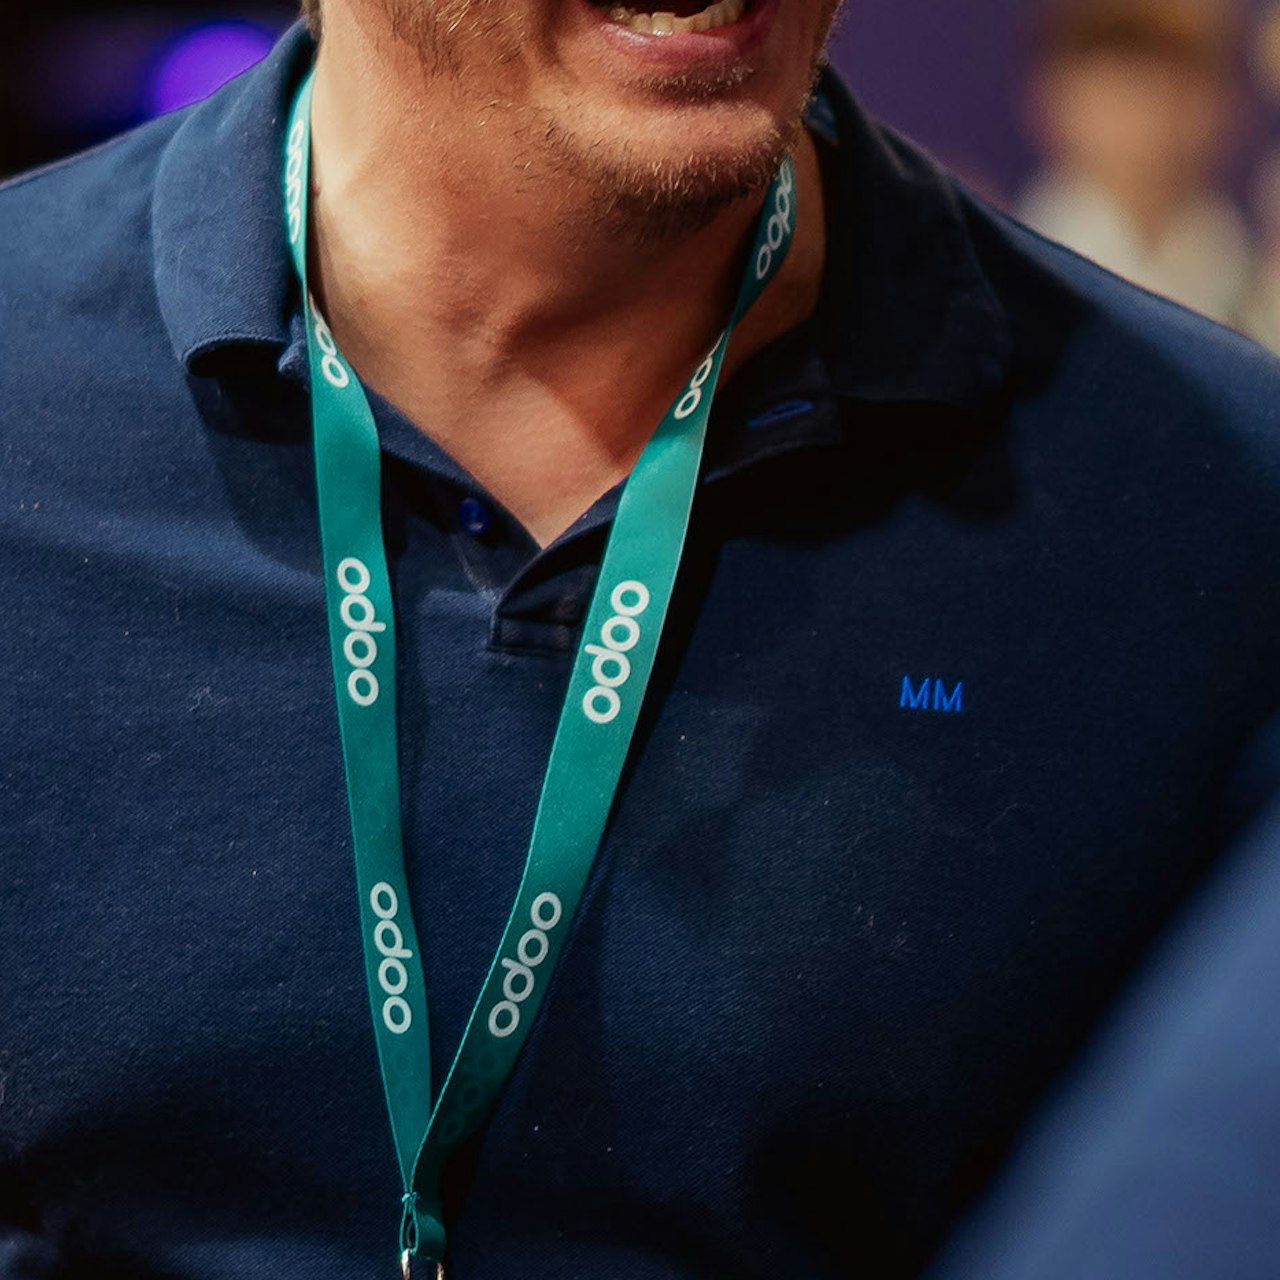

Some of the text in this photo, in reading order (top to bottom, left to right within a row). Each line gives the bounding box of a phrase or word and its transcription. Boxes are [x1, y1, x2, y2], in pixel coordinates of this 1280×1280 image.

[336, 557, 386, 706] odoo
[582, 580, 650, 724] odoo
[899, 674, 963, 713] MM
[370, 881, 413, 1034] odoo
[487, 891, 562, 1038] odoo
